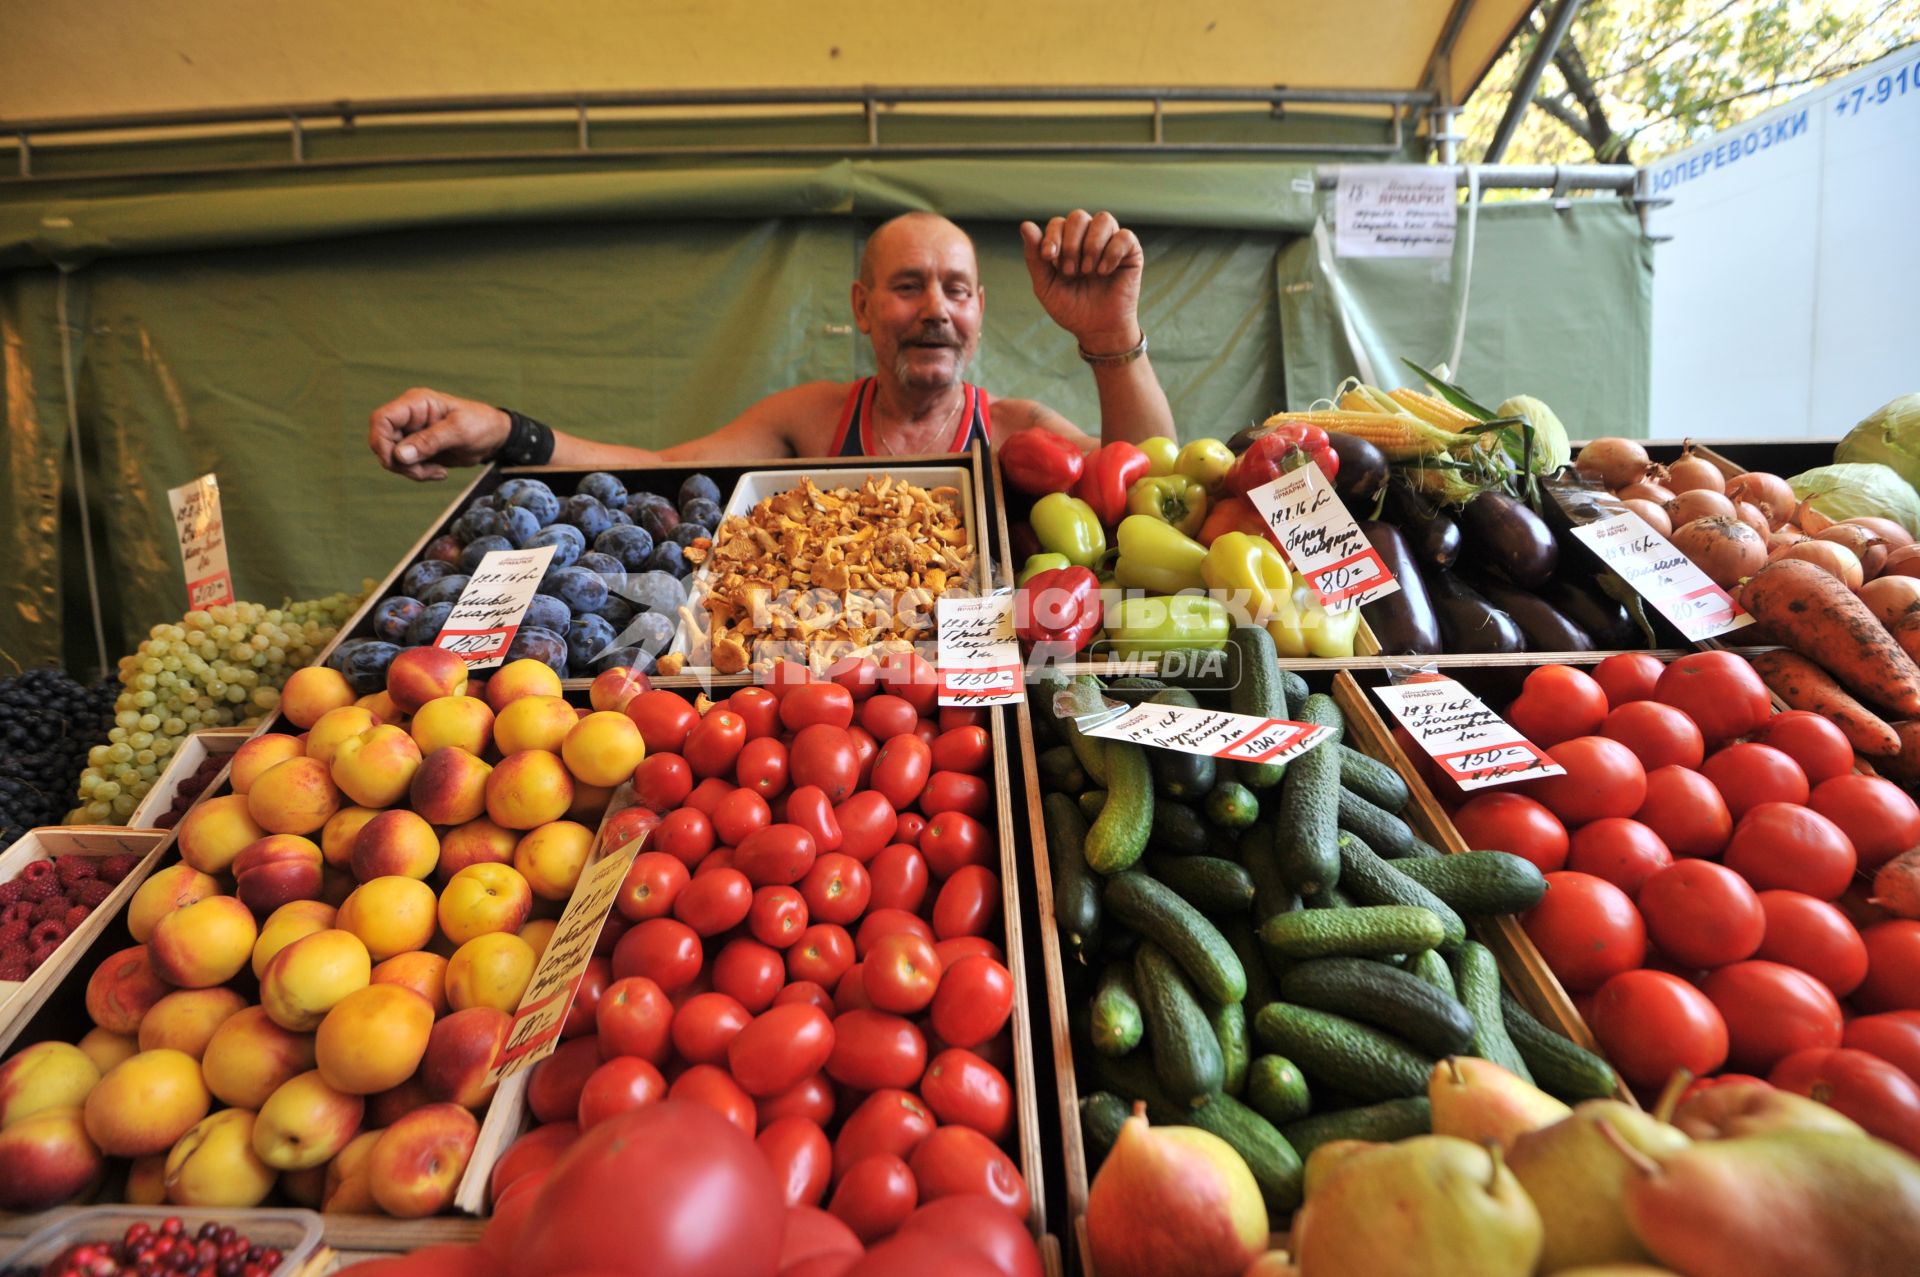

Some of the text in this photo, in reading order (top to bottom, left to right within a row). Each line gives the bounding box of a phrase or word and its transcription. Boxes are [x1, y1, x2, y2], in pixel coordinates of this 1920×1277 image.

[1379, 193, 1444, 204] ЯРМАРКИ
[1273, 481, 1306, 500] ЯРМАРКИ
[1402, 691, 1444, 699] ЯРМАРКИ
